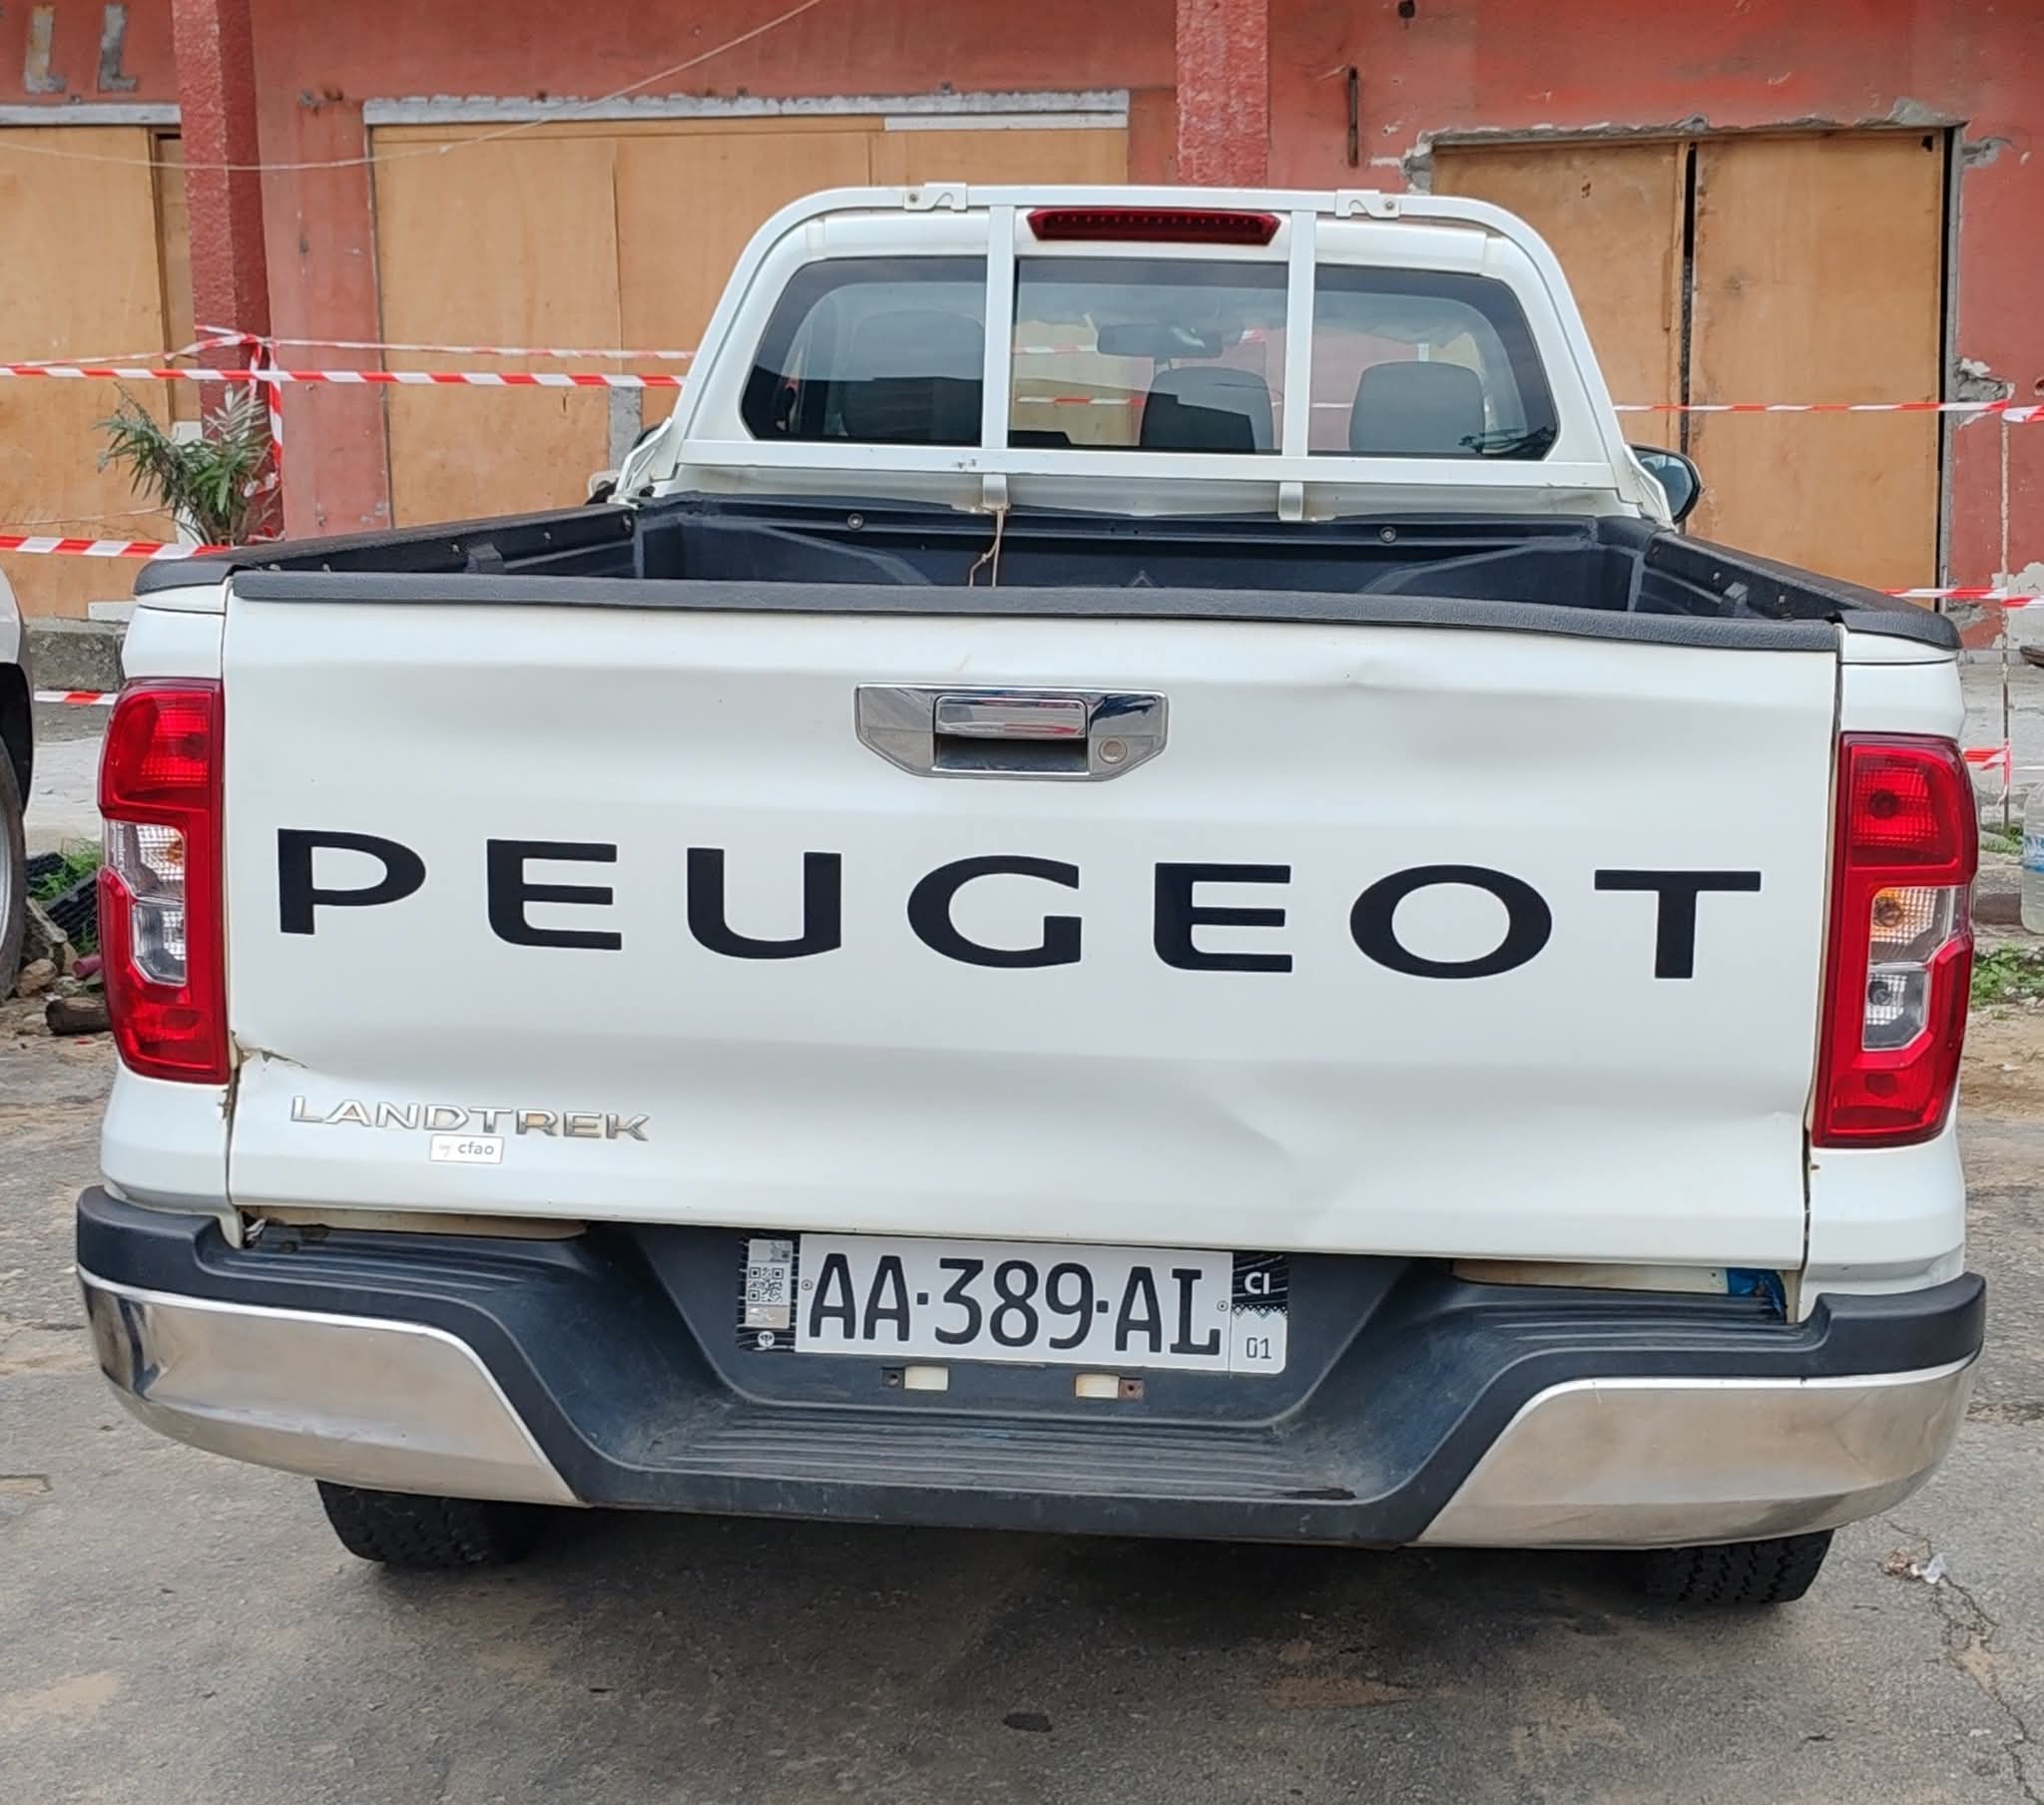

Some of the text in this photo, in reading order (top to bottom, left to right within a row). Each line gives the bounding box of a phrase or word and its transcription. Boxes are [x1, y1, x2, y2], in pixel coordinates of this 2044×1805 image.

[278, 828, 1762, 979] PEUGEOT
[290, 1096, 650, 1141] LANDTREK
[457, 1141, 495, 1155] cfao
[1245, 1271, 1271, 1295] CI
[1246, 1337, 1273, 1360] 01
